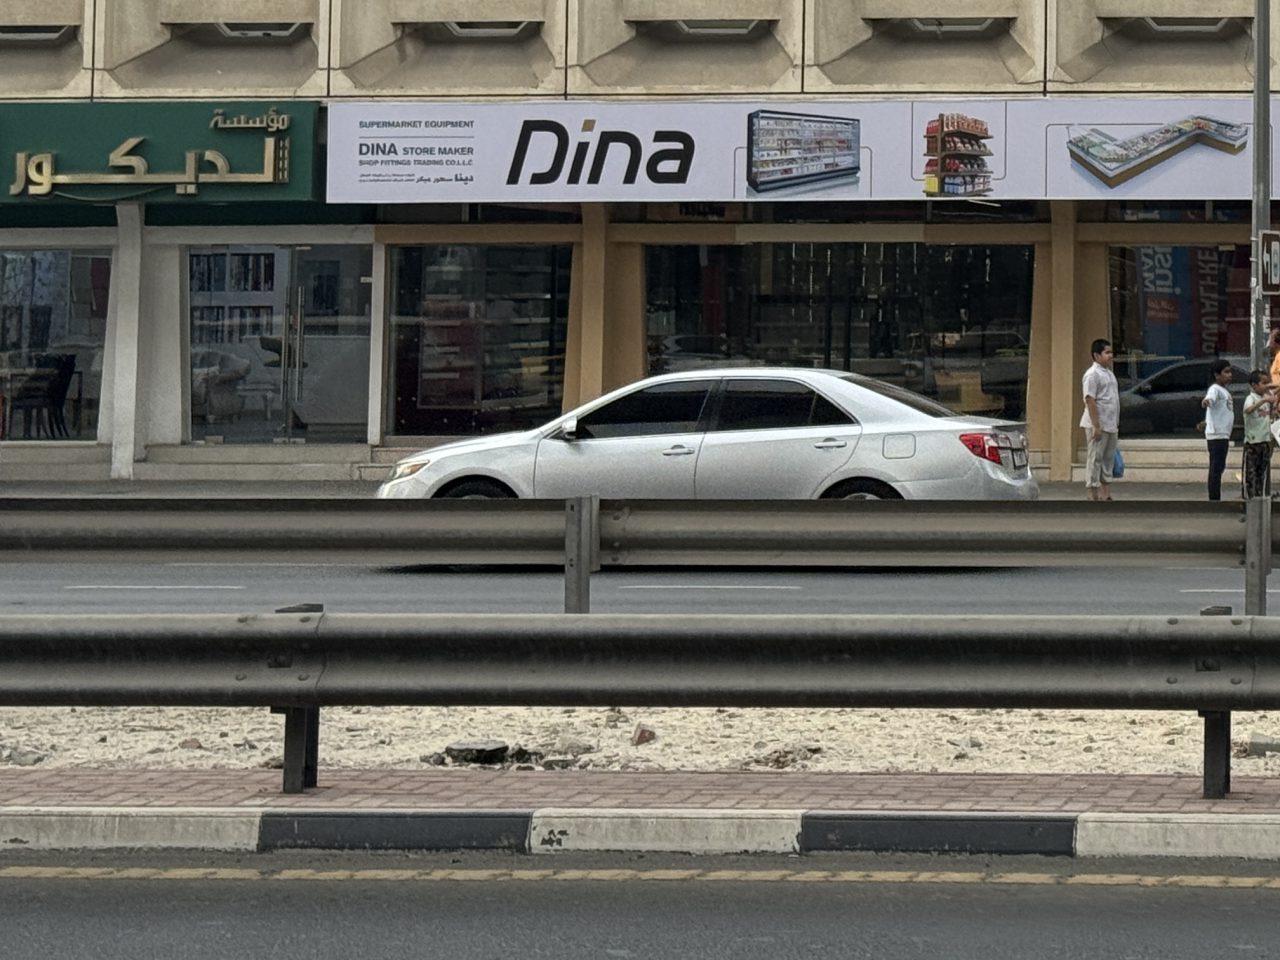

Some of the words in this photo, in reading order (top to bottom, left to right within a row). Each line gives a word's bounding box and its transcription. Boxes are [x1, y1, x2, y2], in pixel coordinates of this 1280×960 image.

[209, 107, 290, 131] مؤسسة
[359, 120, 423, 129] SUPERMARKET
[424, 120, 475, 128] EQUIPMENT
[359, 142, 398, 156] DINA
[402, 146, 436, 156] STORE
[438, 146, 474, 156] MAKER
[506, 119, 695, 185] Dina
[9, 136, 290, 196] الديكور
